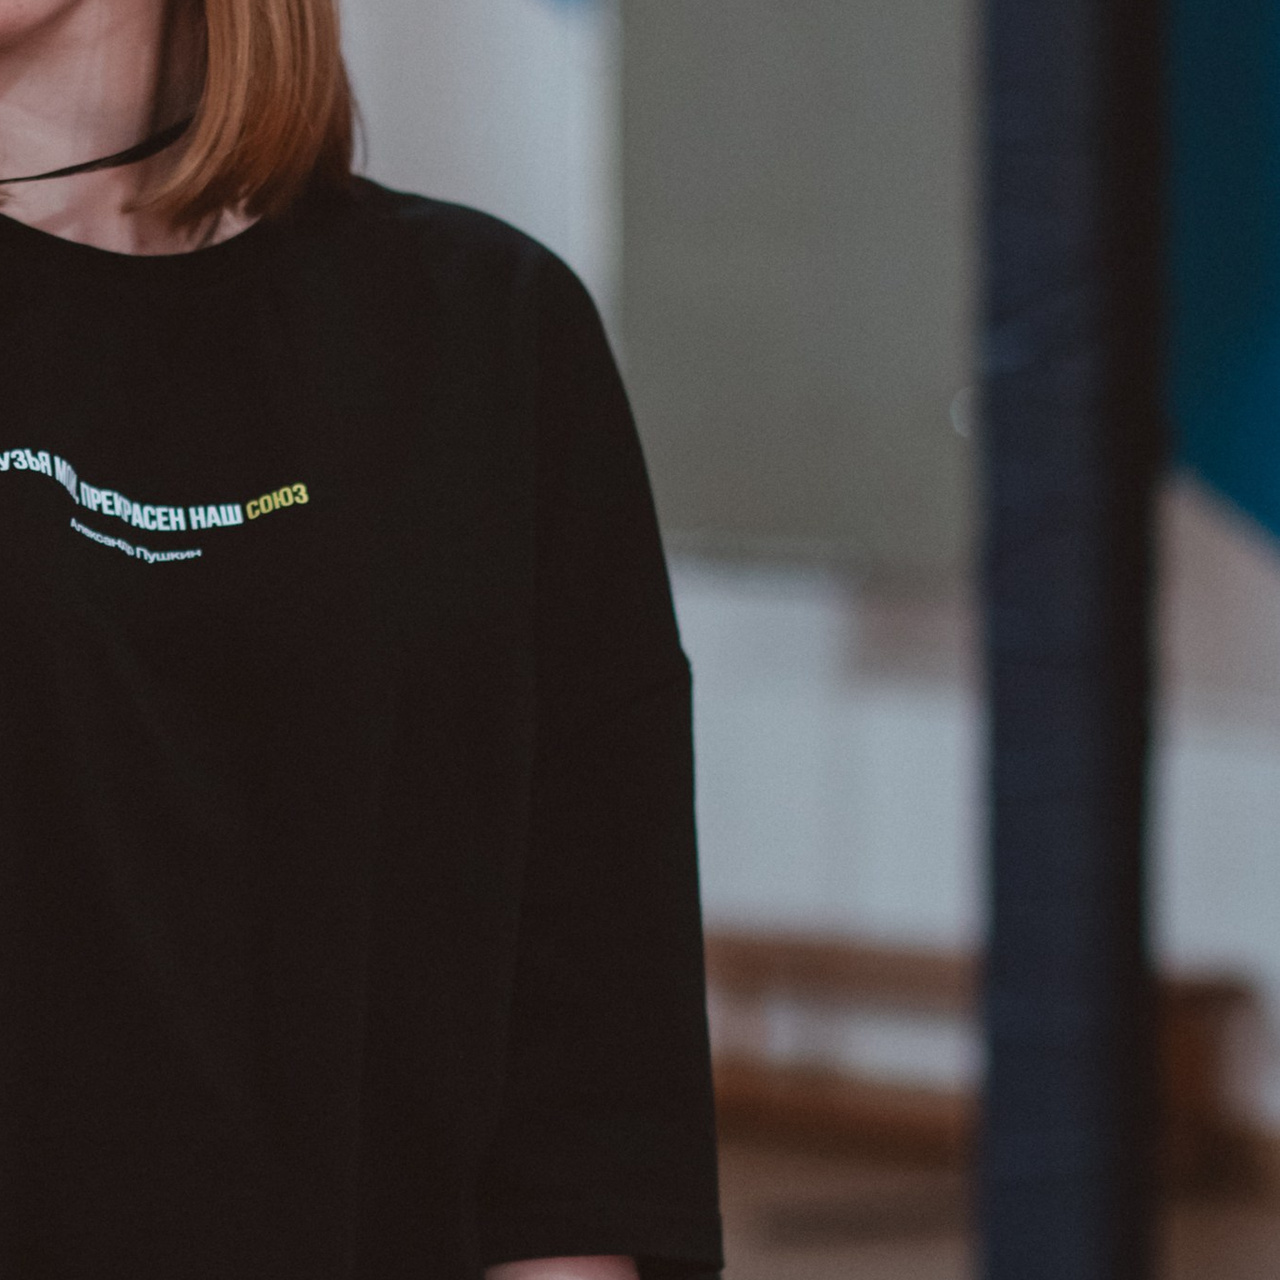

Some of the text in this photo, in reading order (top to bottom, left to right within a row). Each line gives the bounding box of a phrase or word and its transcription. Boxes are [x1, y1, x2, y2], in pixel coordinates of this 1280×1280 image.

[80, 481, 186, 531] ПРЕКРАСЕН
[188, 503, 244, 530] НАШ
[245, 482, 309, 520] СОЮЗ
[70, 518, 203, 564] Александр Пушкин
